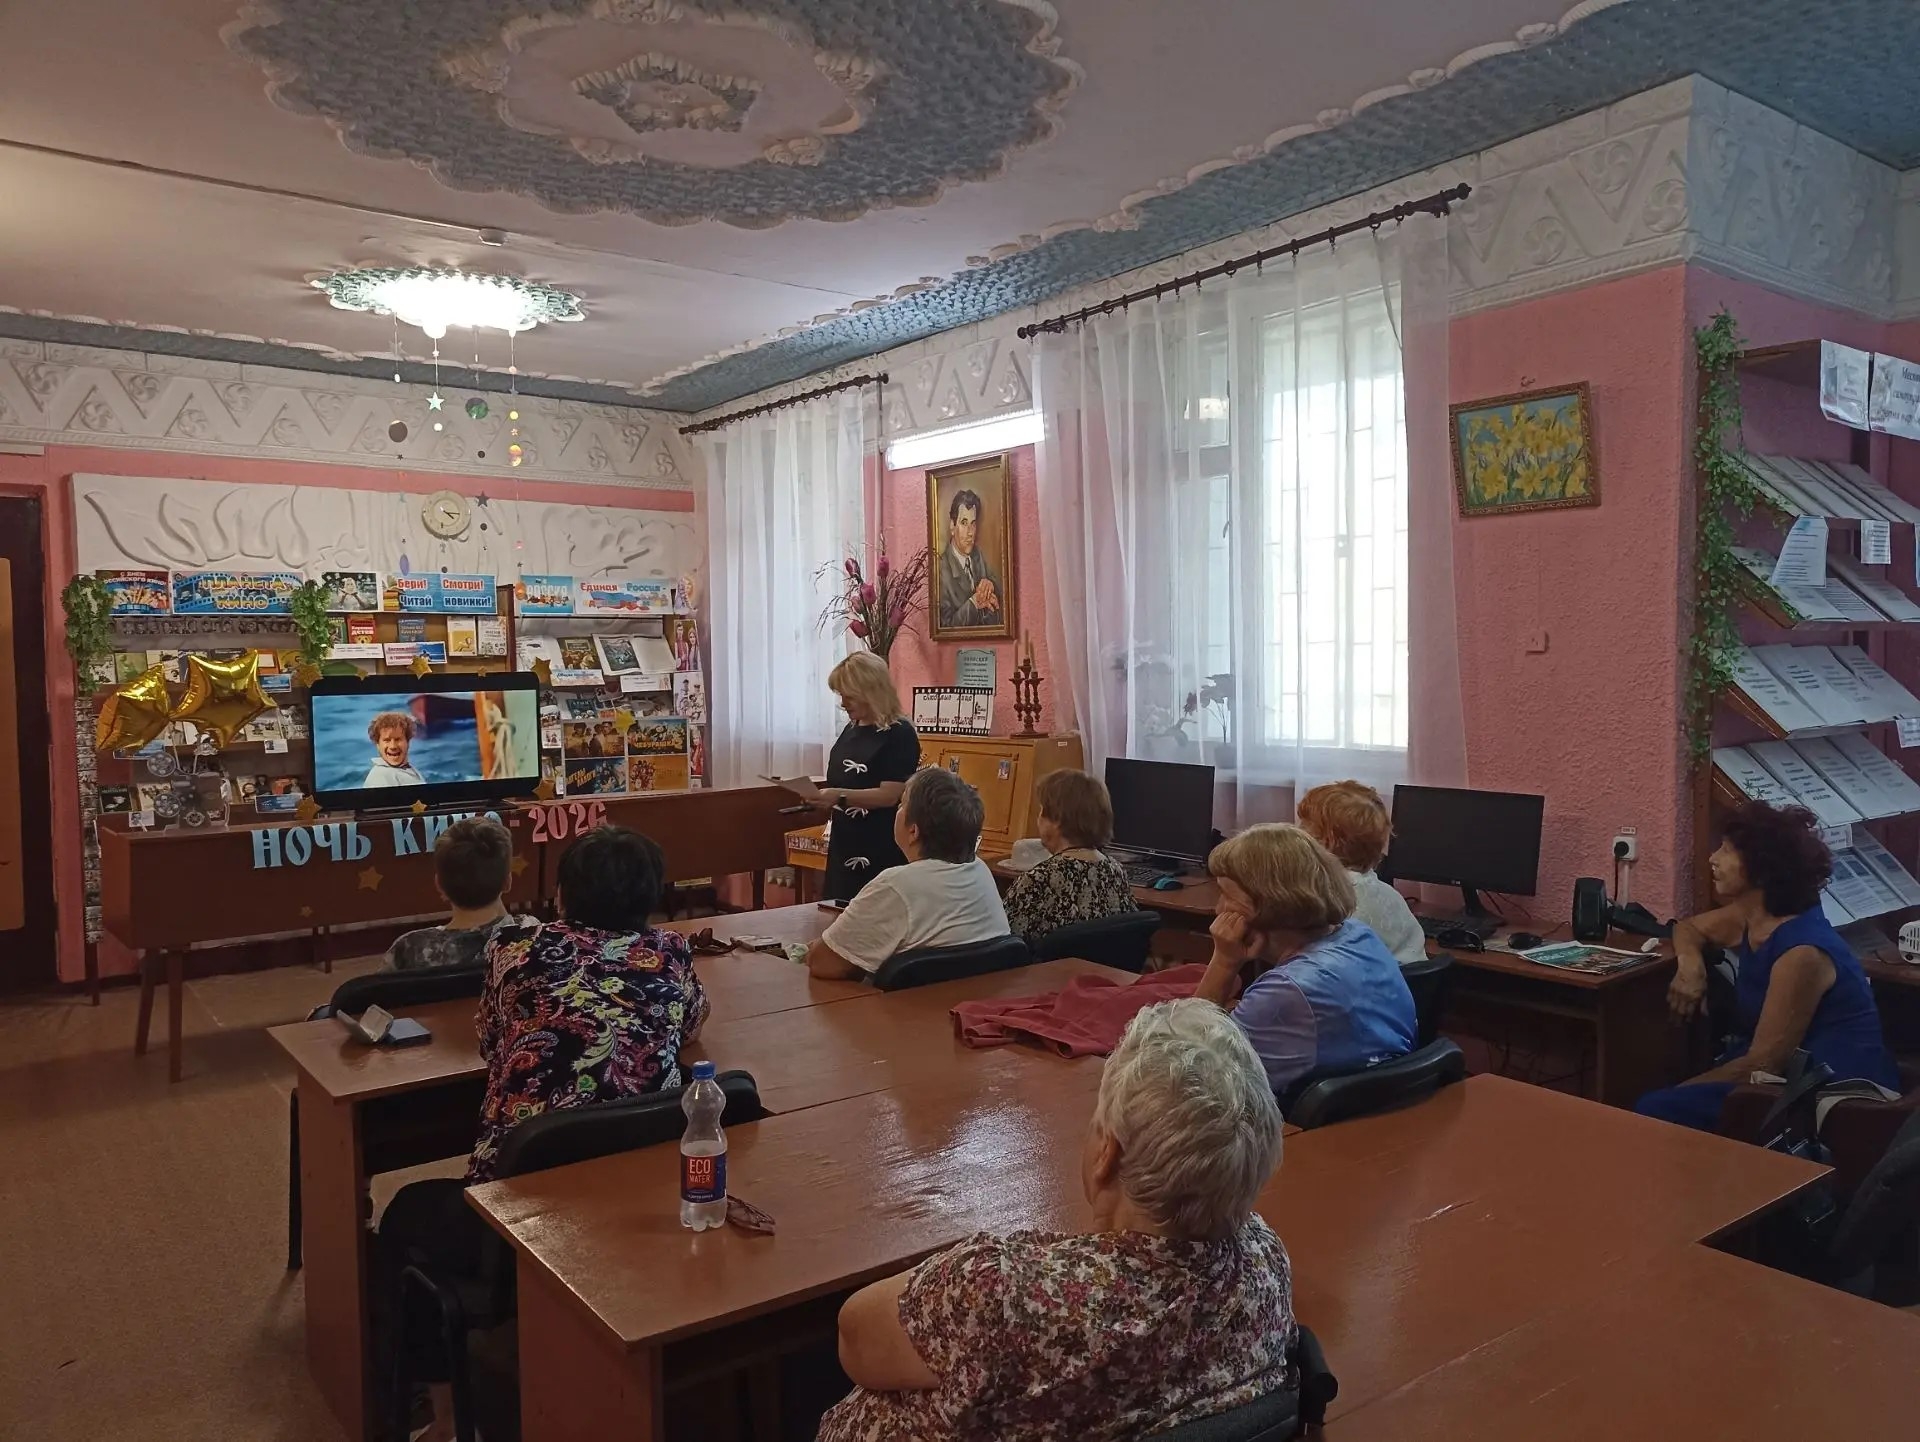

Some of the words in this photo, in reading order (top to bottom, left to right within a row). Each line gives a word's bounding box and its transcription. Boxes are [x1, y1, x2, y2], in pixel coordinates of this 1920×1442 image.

[201, 575, 287, 590] ПЛАНЕТА
[397, 578, 428, 590] Бери!
[442, 578, 484, 591] Смотри!
[580, 582, 618, 592] Единая
[626, 582, 660, 592] Россия
[216, 595, 270, 610] КИНО
[400, 594, 432, 607] Читай
[444, 595, 492, 608] новинки!
[251, 822, 372, 869] НОЧЬ
[528, 801, 606, 843] 2026
[689, 1159, 711, 1175] ECO
[689, 1175, 711, 1184] WATER
